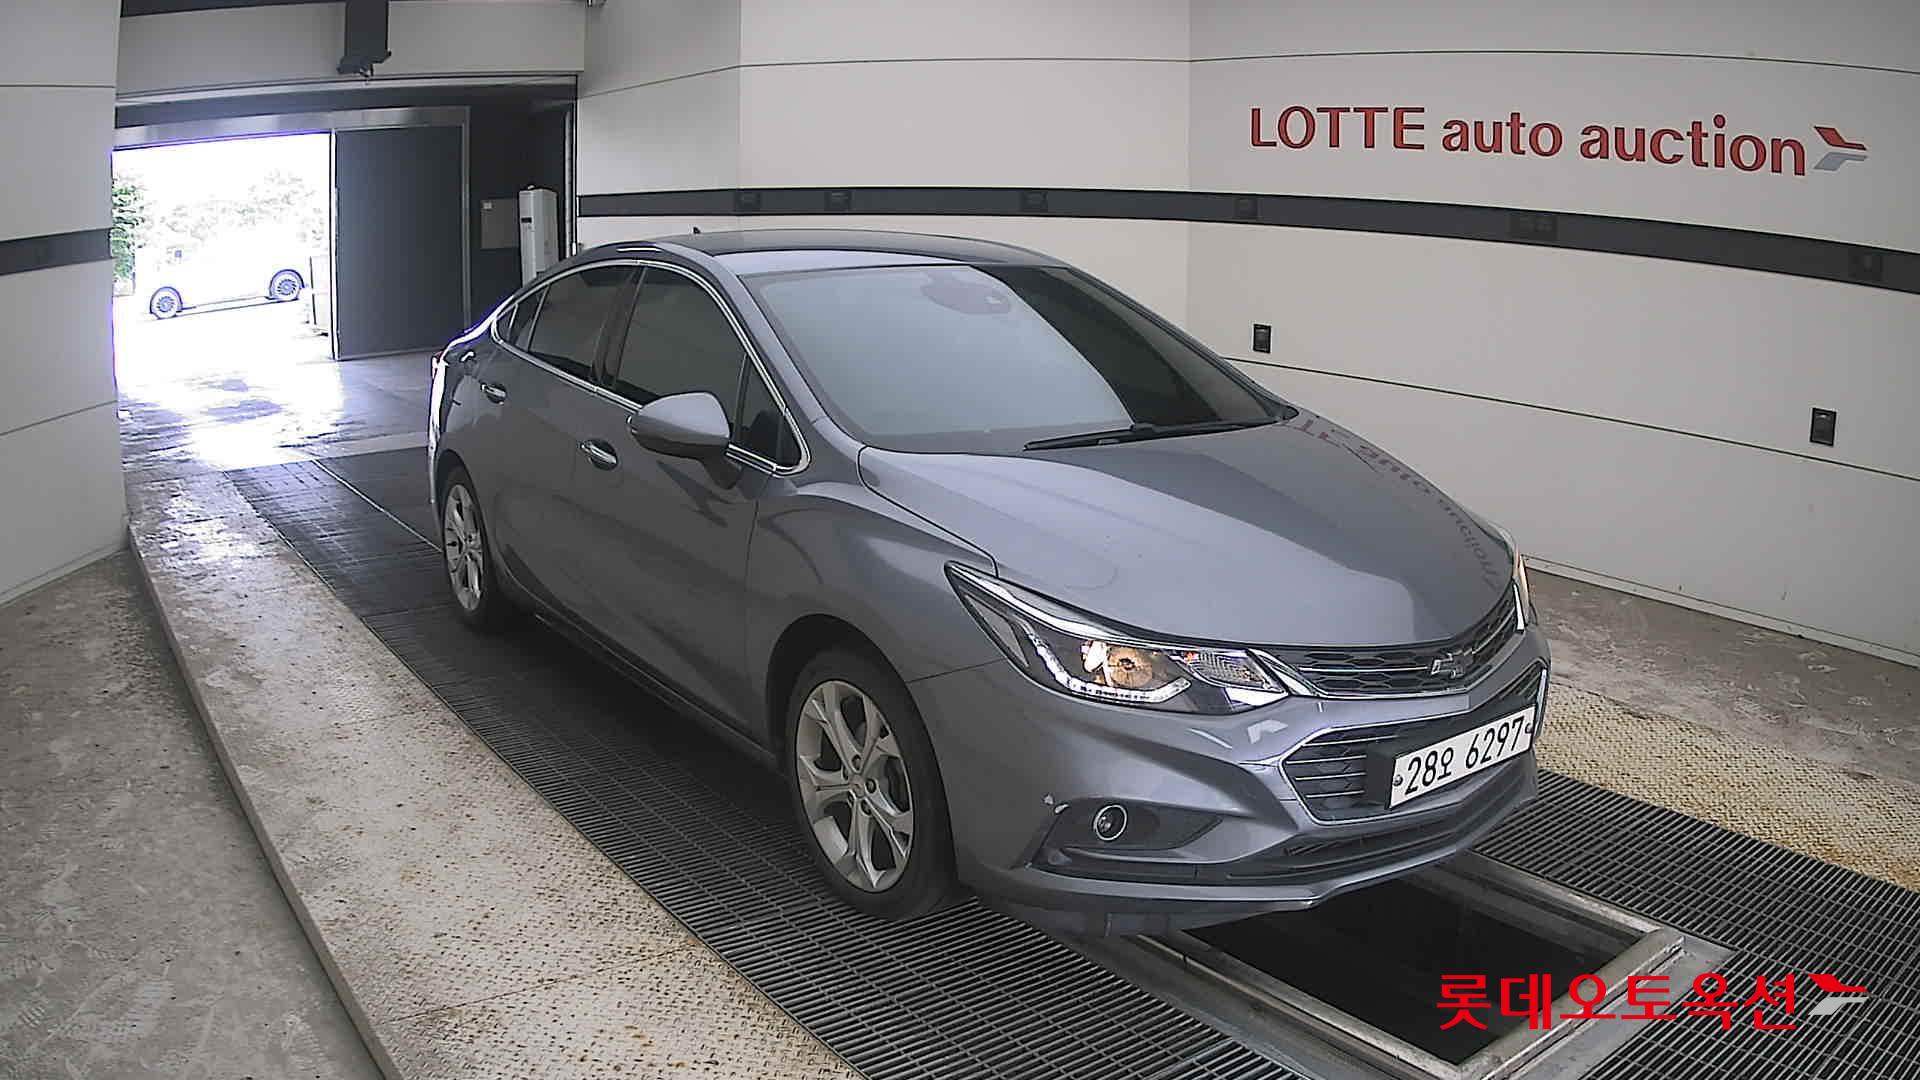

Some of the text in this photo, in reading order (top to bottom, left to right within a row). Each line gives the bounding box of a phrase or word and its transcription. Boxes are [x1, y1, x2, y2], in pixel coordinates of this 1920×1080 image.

[1250, 105, 1807, 176] LOTTE auto auction
[1404, 715, 1526, 796] 28오 6297
